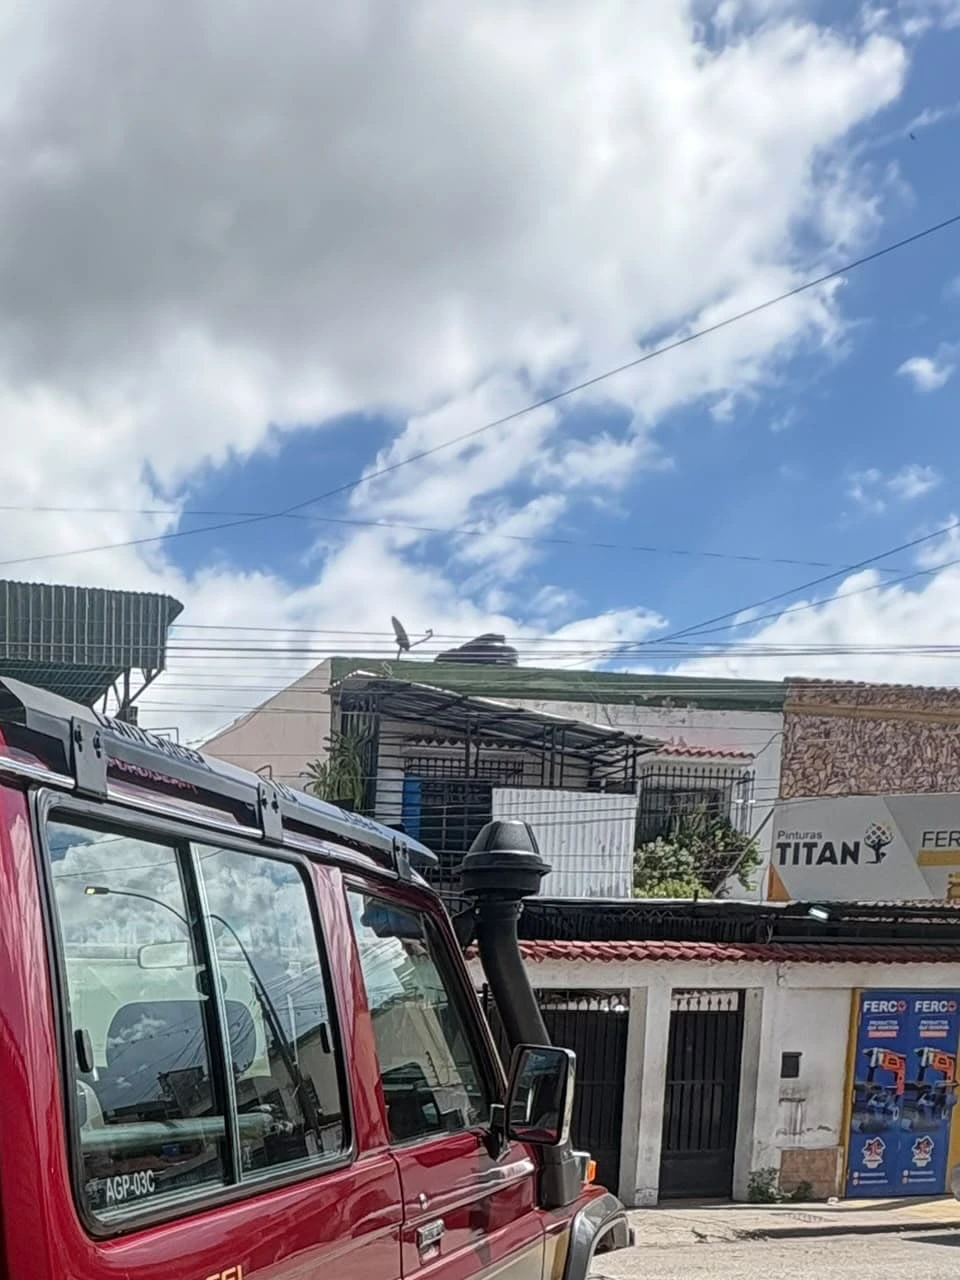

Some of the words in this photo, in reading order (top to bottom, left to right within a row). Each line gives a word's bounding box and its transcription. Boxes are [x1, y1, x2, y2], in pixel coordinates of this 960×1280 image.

[777, 830, 823, 840] Pinturas
[775, 841, 861, 866] TITAN
[105, 1169, 156, 1203] AGP-03C
